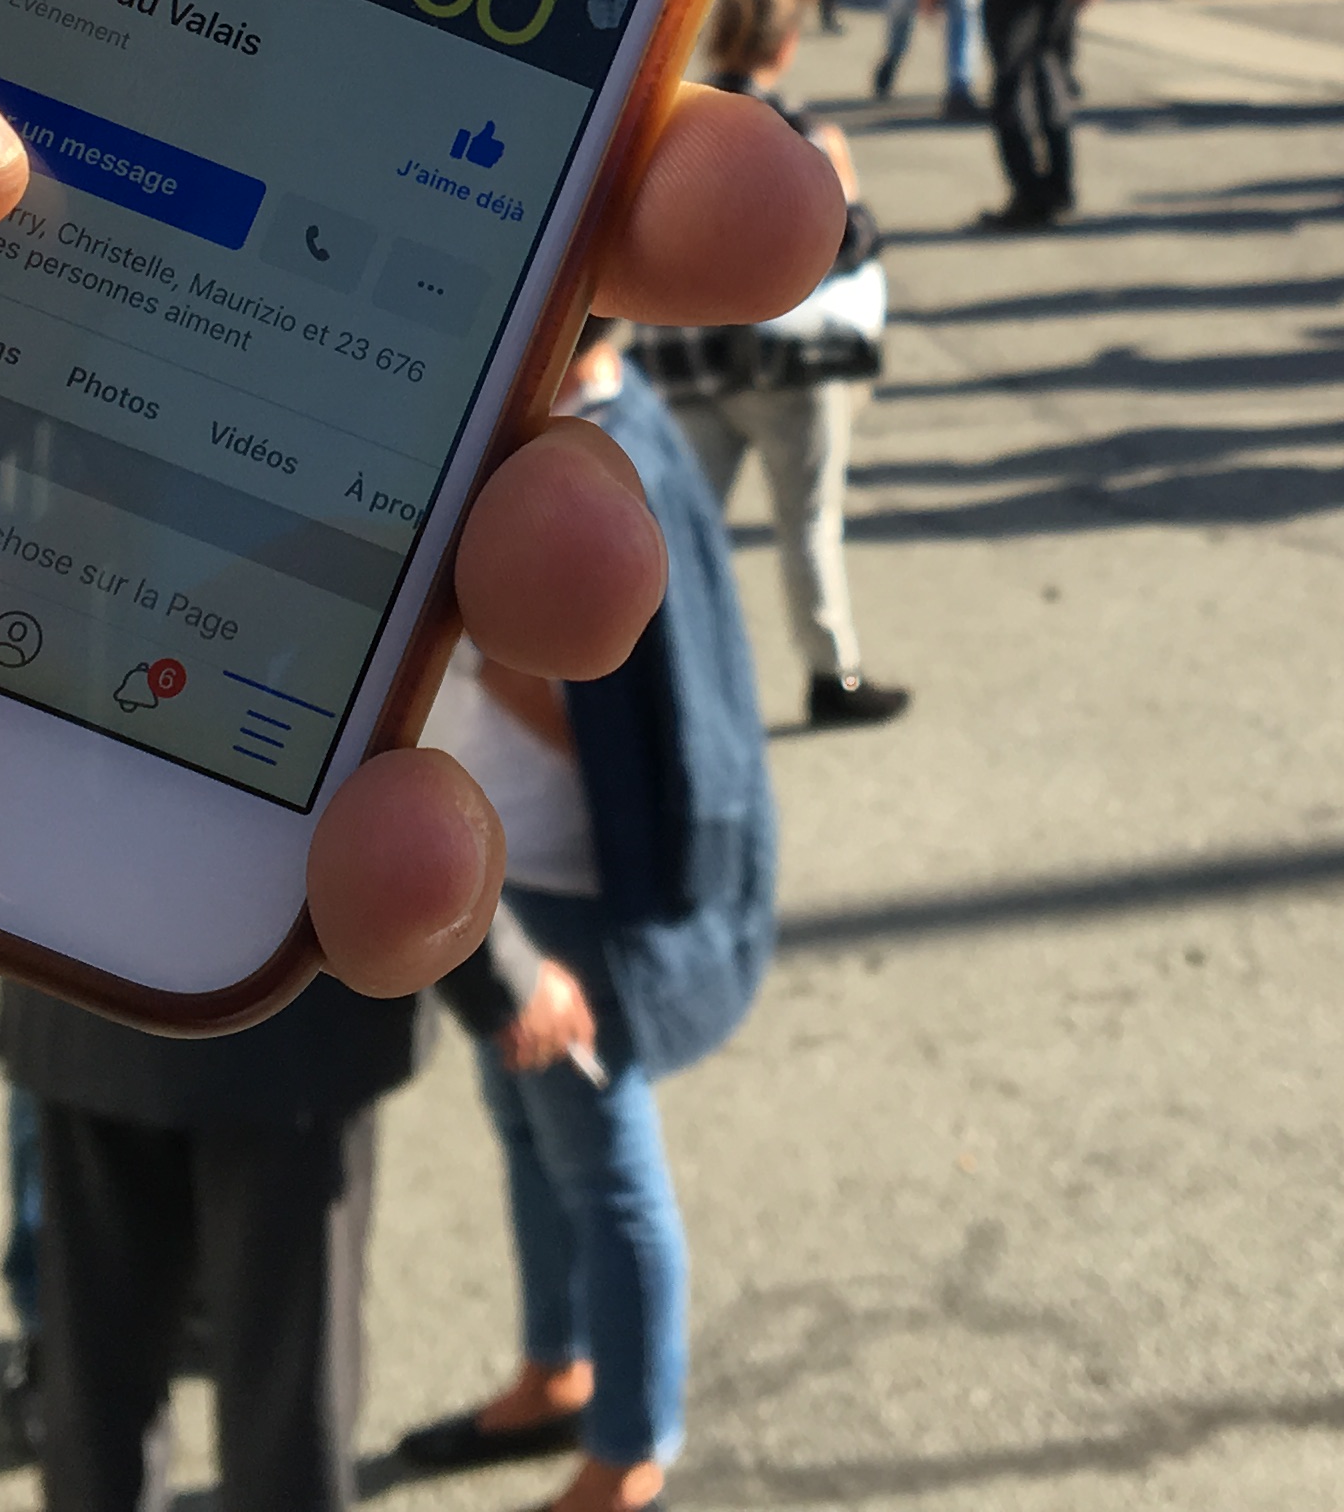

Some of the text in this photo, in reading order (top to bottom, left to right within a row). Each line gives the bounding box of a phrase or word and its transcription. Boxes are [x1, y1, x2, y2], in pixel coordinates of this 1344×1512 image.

[21, 120, 178, 195] un message
[396, 159, 525, 222] J'aime déjà
[7, 206, 427, 383] rry, Christelle, Maurizio et 23 676
[24, 249, 159, 314] personnes
[165, 304, 254, 352] aiment
[65, 366, 161, 420] Photos
[210, 420, 299, 475] Vidéos
[344, 471, 365, 502] À
[79, 564, 130, 596] sur
[133, 578, 159, 611] la
[164, 592, 240, 641] Page
[157, 667, 177, 689] 6
